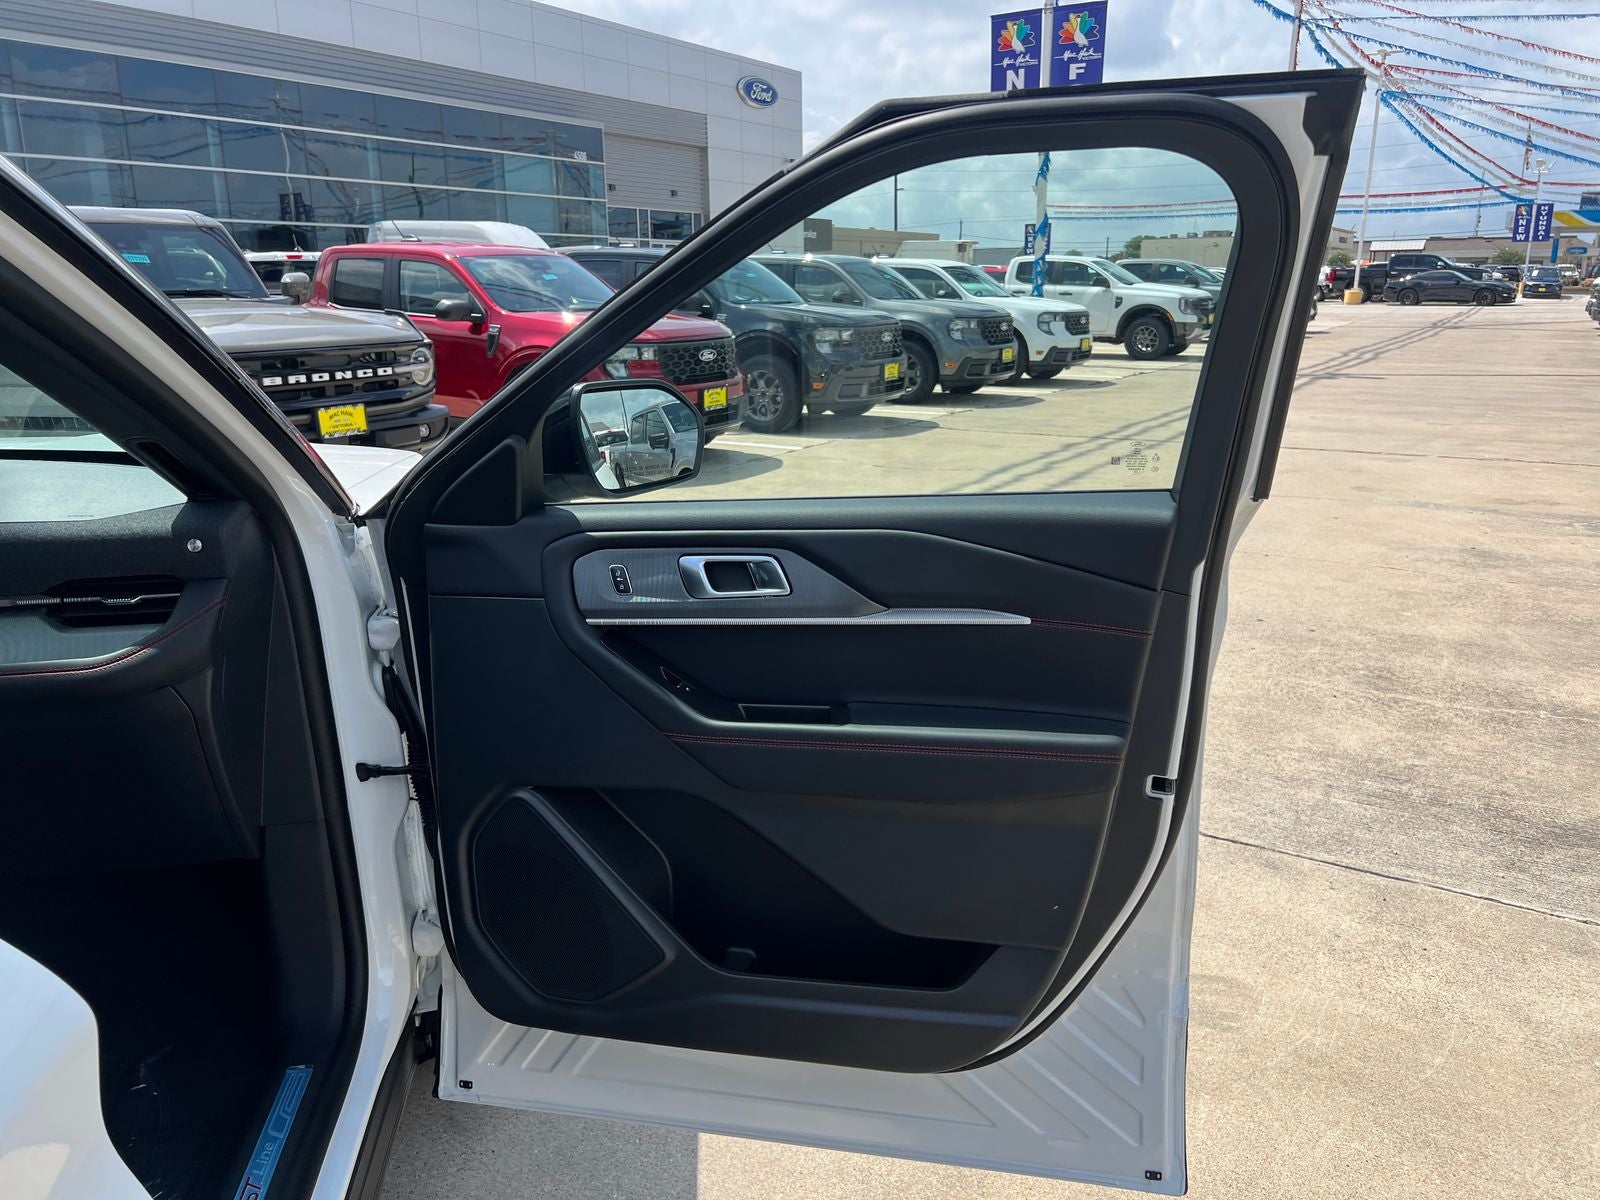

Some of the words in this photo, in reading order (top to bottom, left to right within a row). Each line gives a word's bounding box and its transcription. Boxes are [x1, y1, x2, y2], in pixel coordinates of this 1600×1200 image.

[1006, 69, 1025, 91] N
[1069, 62, 1086, 80] F
[750, 82, 773, 102] Ford
[1516, 219, 1527, 241] NEW
[1537, 205, 1549, 240] HYUNDAI
[262, 367, 393, 386] BRONCO
[252, 1142, 274, 1175] Line
